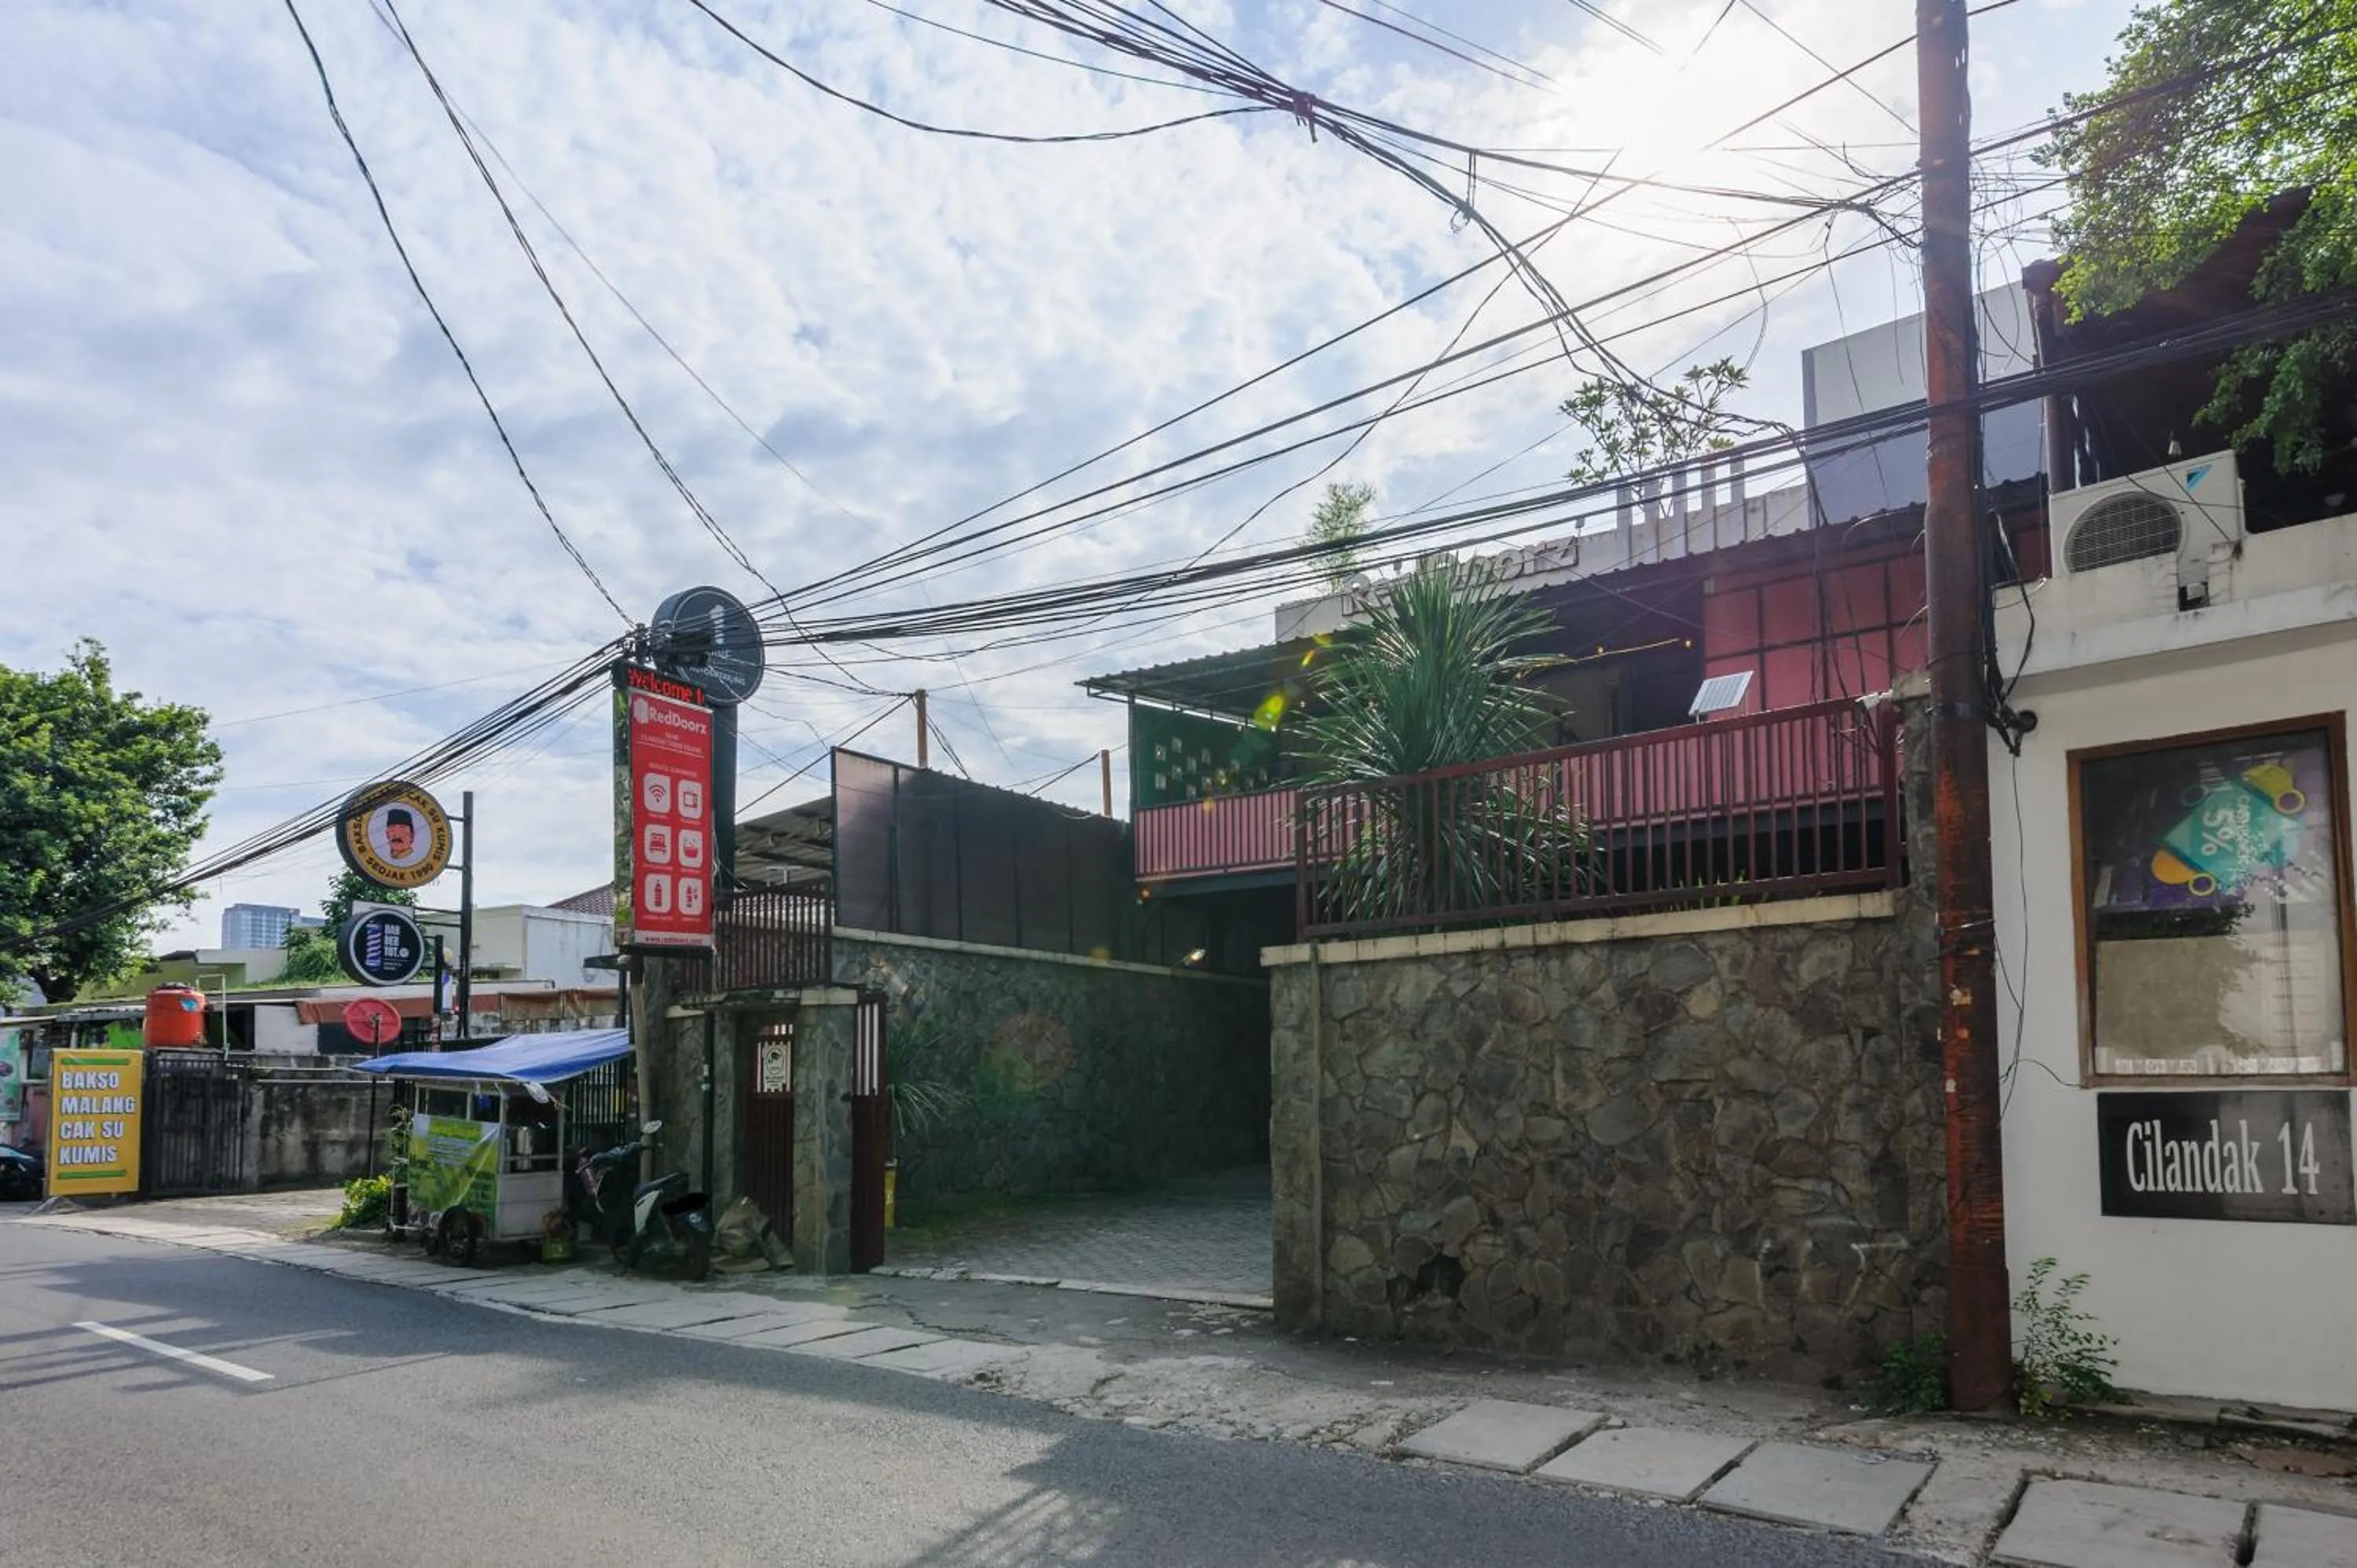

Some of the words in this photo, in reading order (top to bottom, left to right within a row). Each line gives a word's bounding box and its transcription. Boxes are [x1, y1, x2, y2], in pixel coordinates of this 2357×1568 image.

[649, 706, 707, 735] RedDoorz
[433, 826, 446, 862] KUMIS
[2201, 808, 2235, 856] 5%
[60, 1071, 119, 1090] BAKSO
[60, 1095, 137, 1115] MALANG
[59, 1120, 95, 1139] CAK
[101, 1119, 124, 1138] SU
[58, 1144, 118, 1165] KUMIS
[2126, 1119, 2264, 1192] Cilandak
[2278, 1121, 2320, 1196] 14
